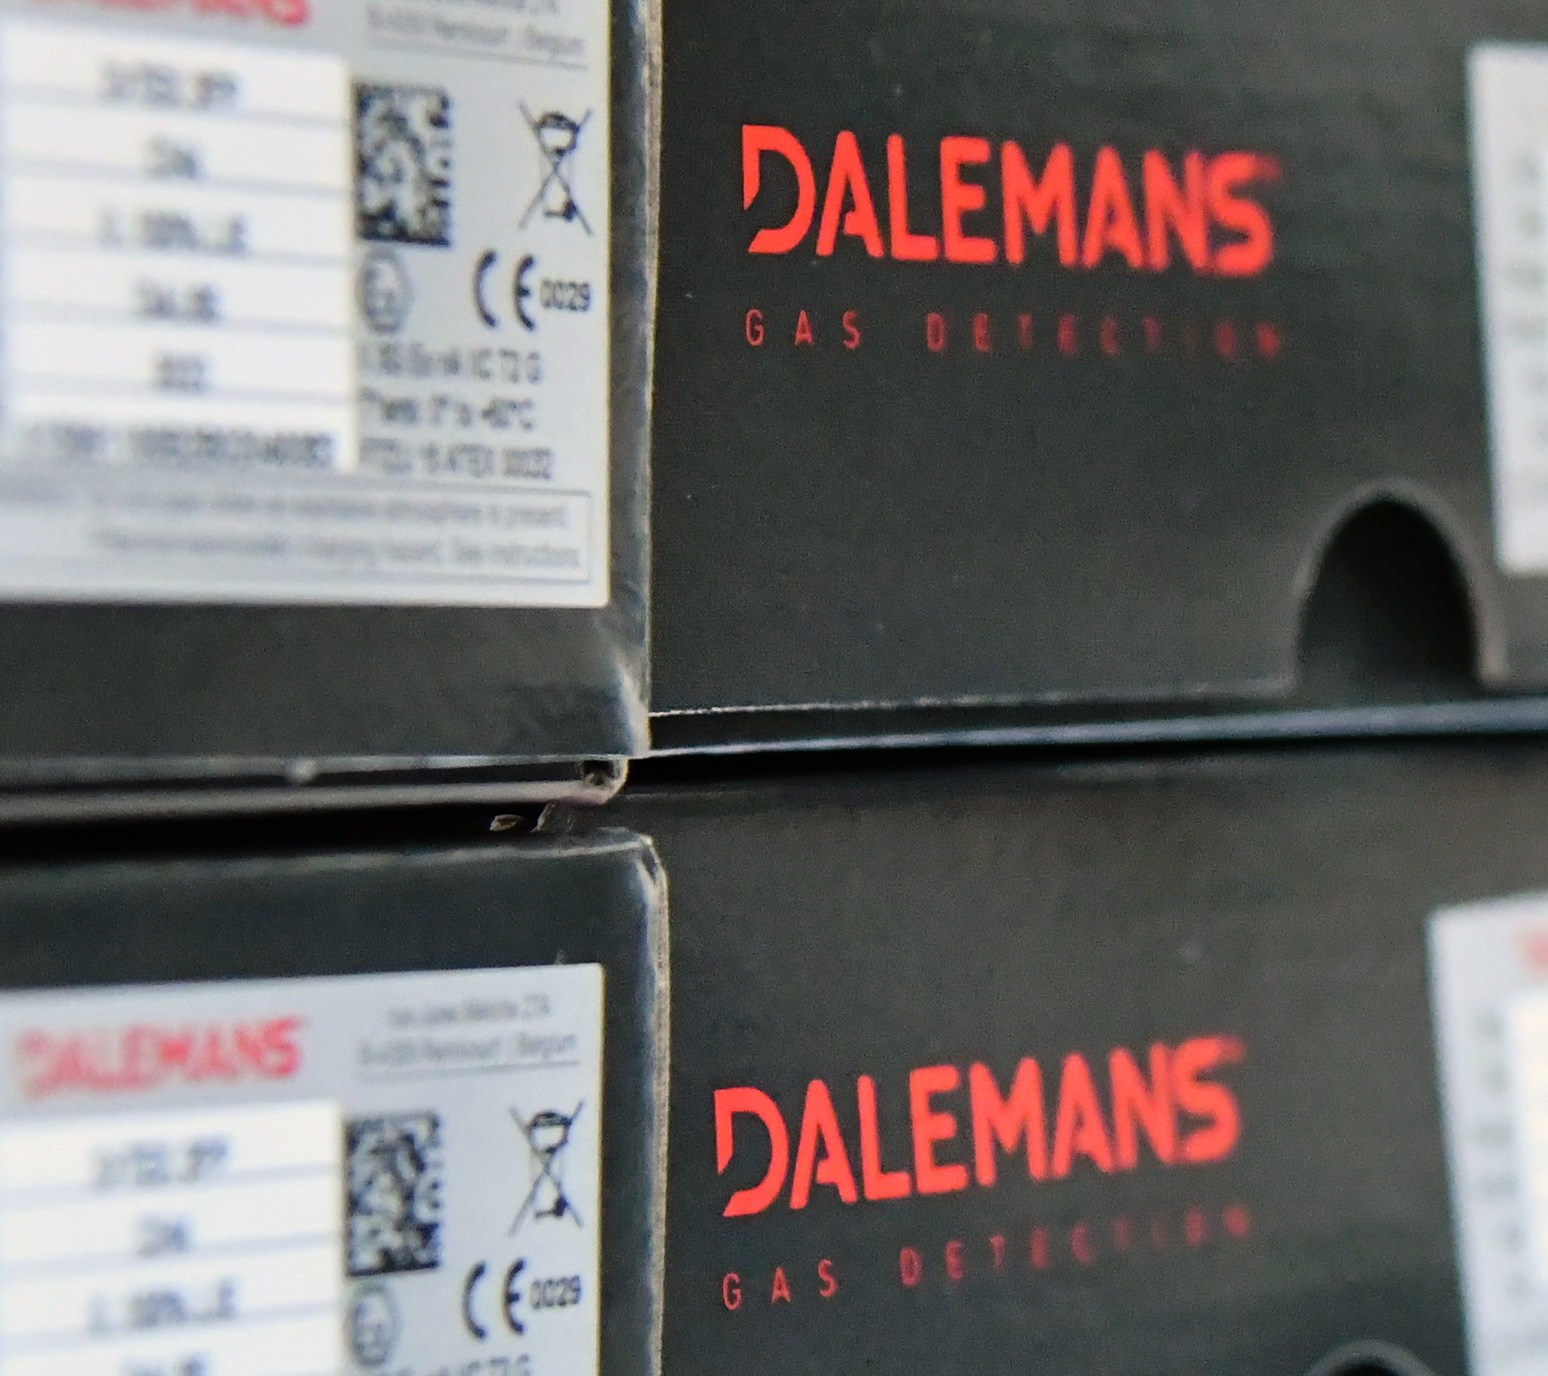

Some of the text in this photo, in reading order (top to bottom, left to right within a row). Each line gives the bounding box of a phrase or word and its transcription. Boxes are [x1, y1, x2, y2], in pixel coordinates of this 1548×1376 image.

[741, 124, 1279, 277] DALEMANS
[540, 278, 590, 312] 0029
[745, 309, 861, 350] GAS
[15, 1016, 305, 1098] DALEMANS
[713, 1034, 1245, 1217] DALEMANS
[531, 1275, 580, 1310] 0029
[722, 1259, 839, 1310] GAS
